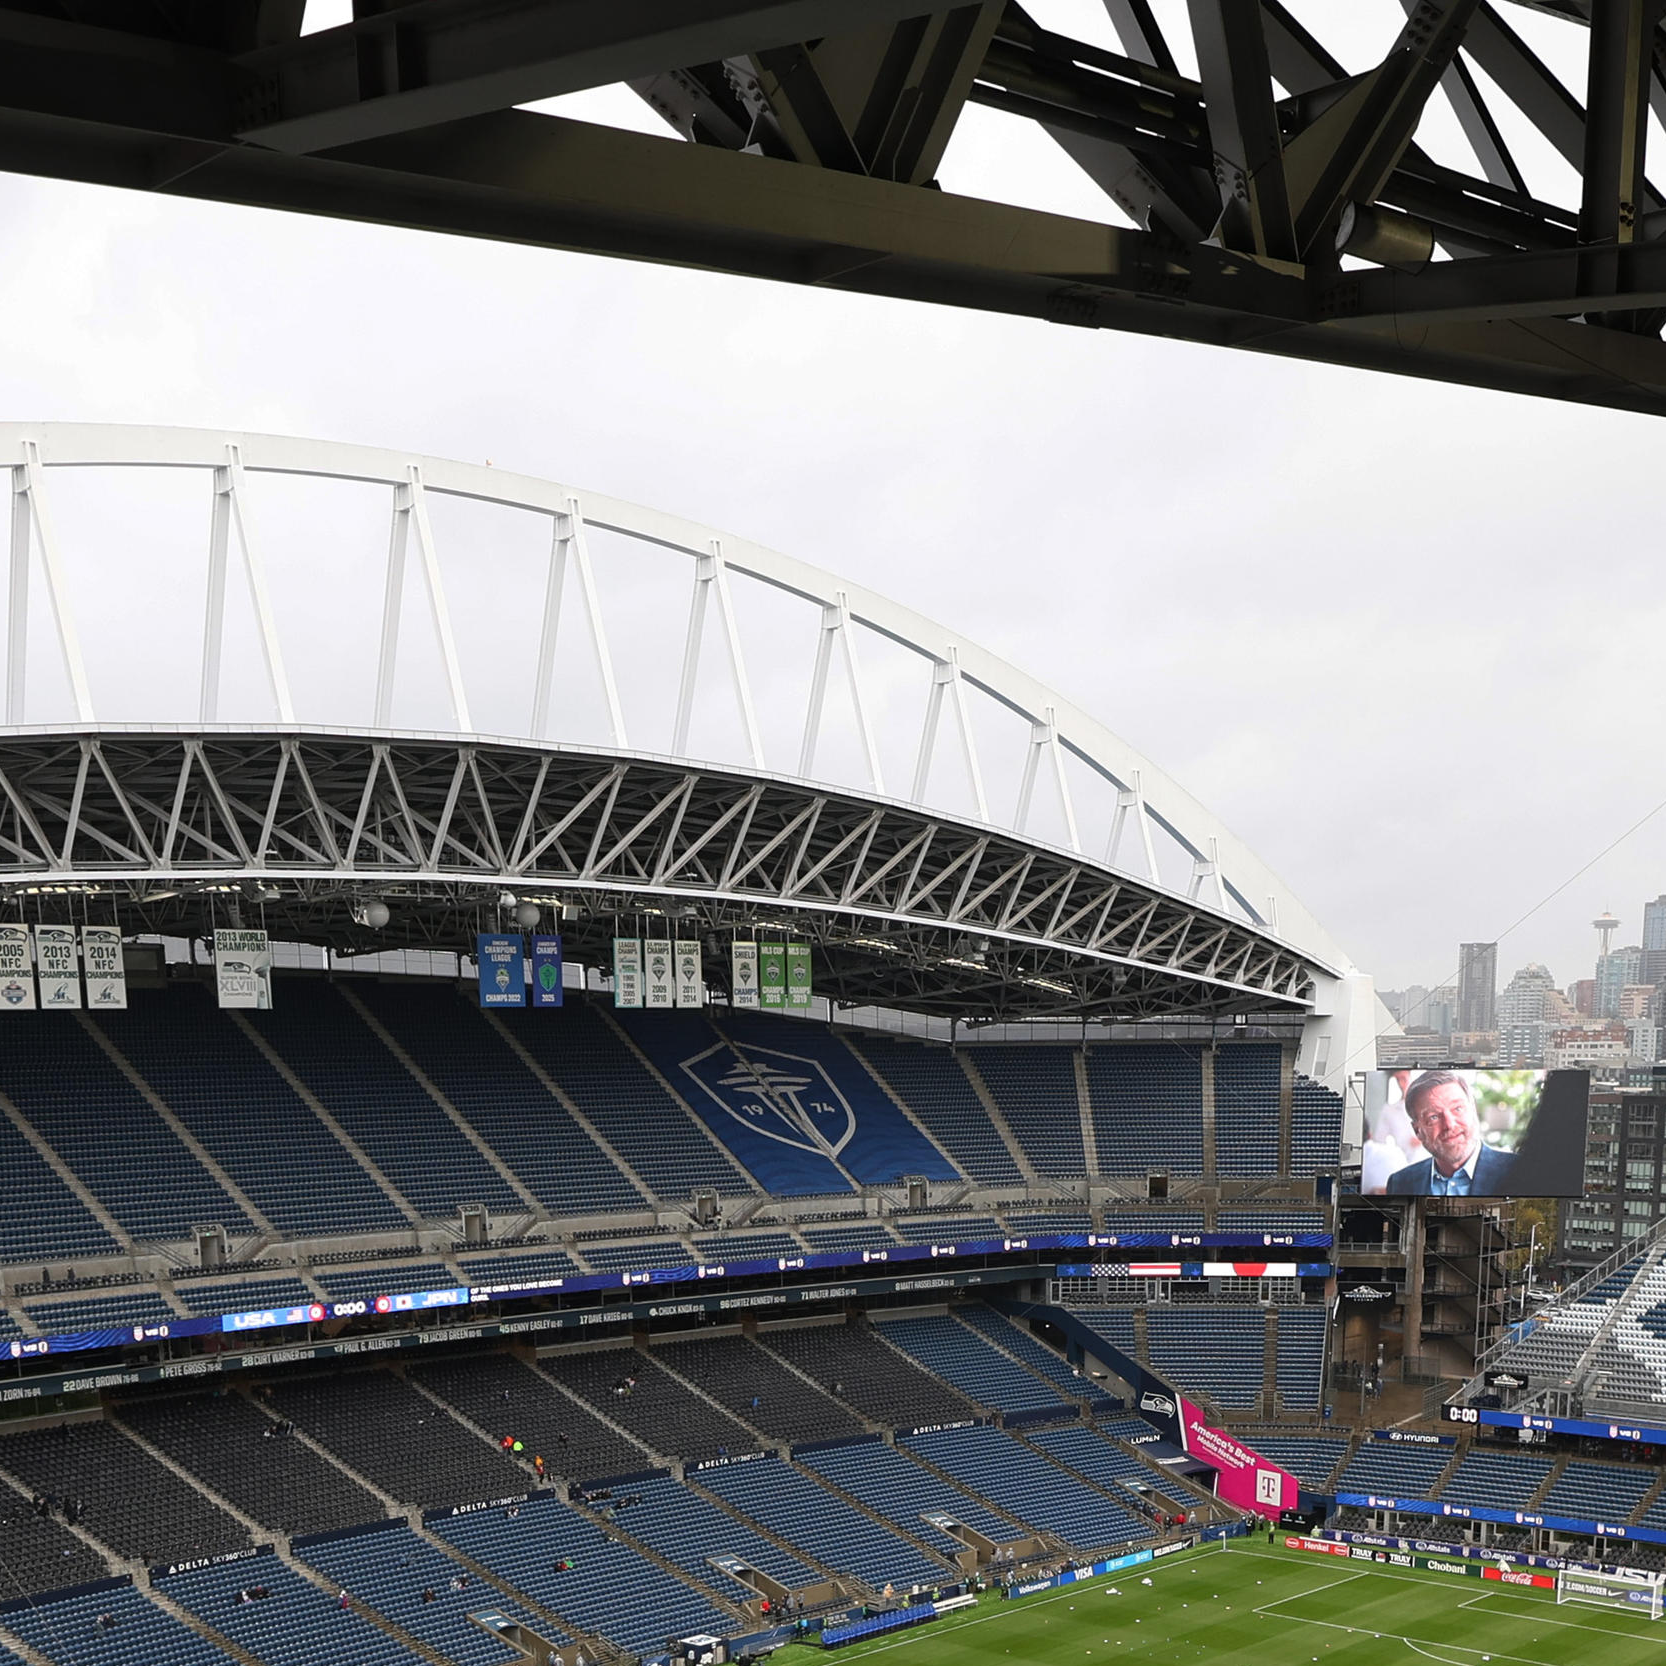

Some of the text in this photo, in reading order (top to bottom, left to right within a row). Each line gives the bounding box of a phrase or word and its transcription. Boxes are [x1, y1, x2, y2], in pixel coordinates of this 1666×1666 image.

[216, 932, 265, 942] 2013 WORLD
[43, 946, 71, 958] 2013
[90, 947, 117, 959] 2014
[217, 942, 266, 952] CHAMPIONS
[0, 958, 21, 968] NFC
[48, 960, 69, 970] NFC
[95, 960, 114, 970] NFC
[38, 970, 79, 979] CHAMPIONS
[85, 971, 125, 979] CHAMPIONS
[220, 980, 257, 992] XLVIII
[742, 1104, 763, 1115] 19
[810, 1102, 835, 1113] 74
[509, 1283, 522, 1291] YOU
[523, 1282, 538, 1290] LOVE
[538, 1279, 563, 1288] BECOME
[235, 1291, 457, 1328] USA 0:00 JPN
[530, 1319, 550, 1330] EASLEY
[449, 1329, 468, 1340] GREEN
[242, 1350, 299, 1367] 28 CURT WARNER
[165, 1361, 207, 1378] PETE GROSS
[63, 1374, 123, 1392] 22 DAVE BROWN
[3, 1389, 23, 1401] ZORN
[1449, 1406, 1478, 1423] 0:00
[919, 1424, 941, 1433] DELTA
[1190, 1421, 1234, 1453] America's
[1234, 1448, 1256, 1467] Best
[1403, 1433, 1439, 1443] HYUNDAI
[1196, 1435, 1218, 1454] Mobile
[1217, 1448, 1245, 1469] Network
[705, 1458, 729, 1468] DELTA
[1262, 1476, 1276, 1499] T
[460, 1494, 528, 1513] DELTA CLUB
[1304, 1541, 1329, 1552] Henkel
[178, 1548, 257, 1571] DELTA CLUB
[1351, 1547, 1411, 1564] TRULY TRULY
[1074, 1566, 1093, 1580] VISA
[1427, 1560, 1465, 1574] Chobani
